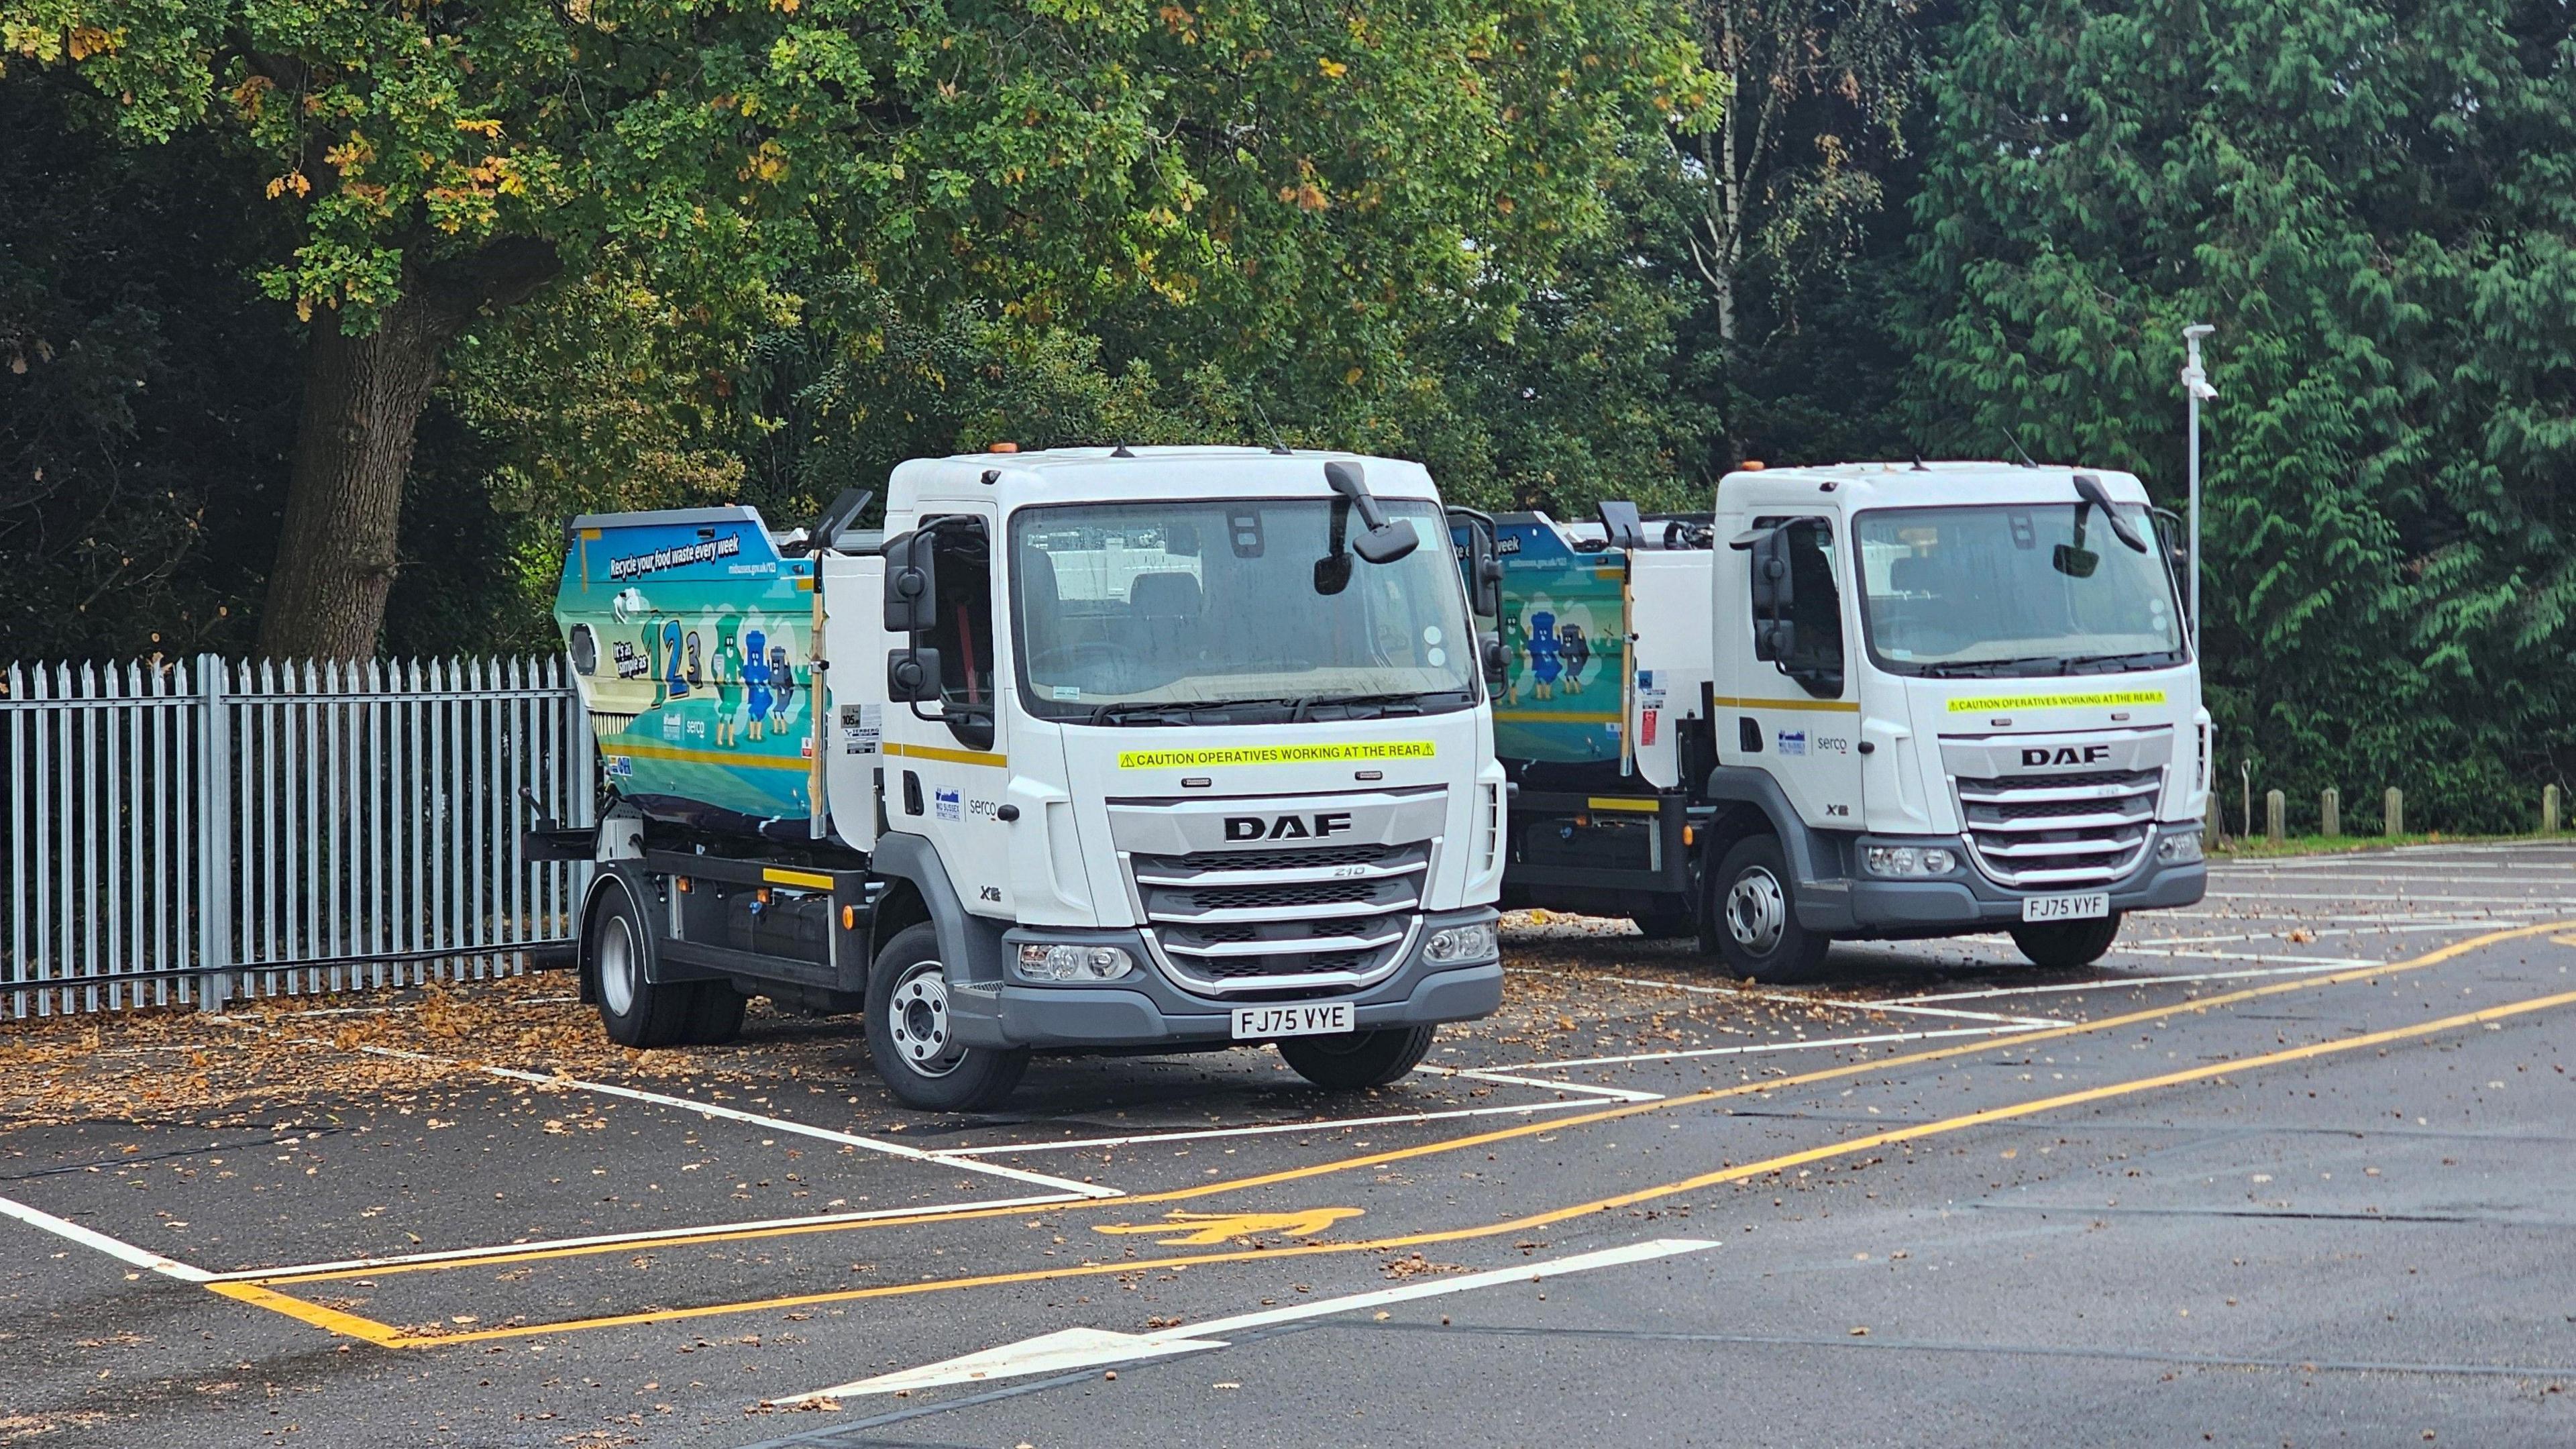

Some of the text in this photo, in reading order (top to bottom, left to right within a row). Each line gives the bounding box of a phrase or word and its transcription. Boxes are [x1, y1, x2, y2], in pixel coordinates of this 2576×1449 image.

[610, 535, 739, 579] Recycle your food waste every week
[613, 643, 632, 658] It's as
[641, 609, 703, 709] 1 2 3
[619, 655, 647, 676] simple as
[1960, 692, 2155, 710] CAUTION OPERATIVES WORKING AT THE REAR
[686, 720, 704, 735] serco
[843, 715, 855, 725] 105
[1818, 737, 1847, 750] serco
[1136, 744, 1421, 766] CAUTION OPERATIVES WORKING AT THE REAR
[2021, 745, 2110, 769] DAF
[970, 799, 996, 816] serco
[1224, 812, 1352, 843] DAF
[1334, 867, 1365, 877] 210
[2030, 896, 2102, 918] FJ75 VYF
[1242, 1006, 1344, 1033] FJ75 VYE
